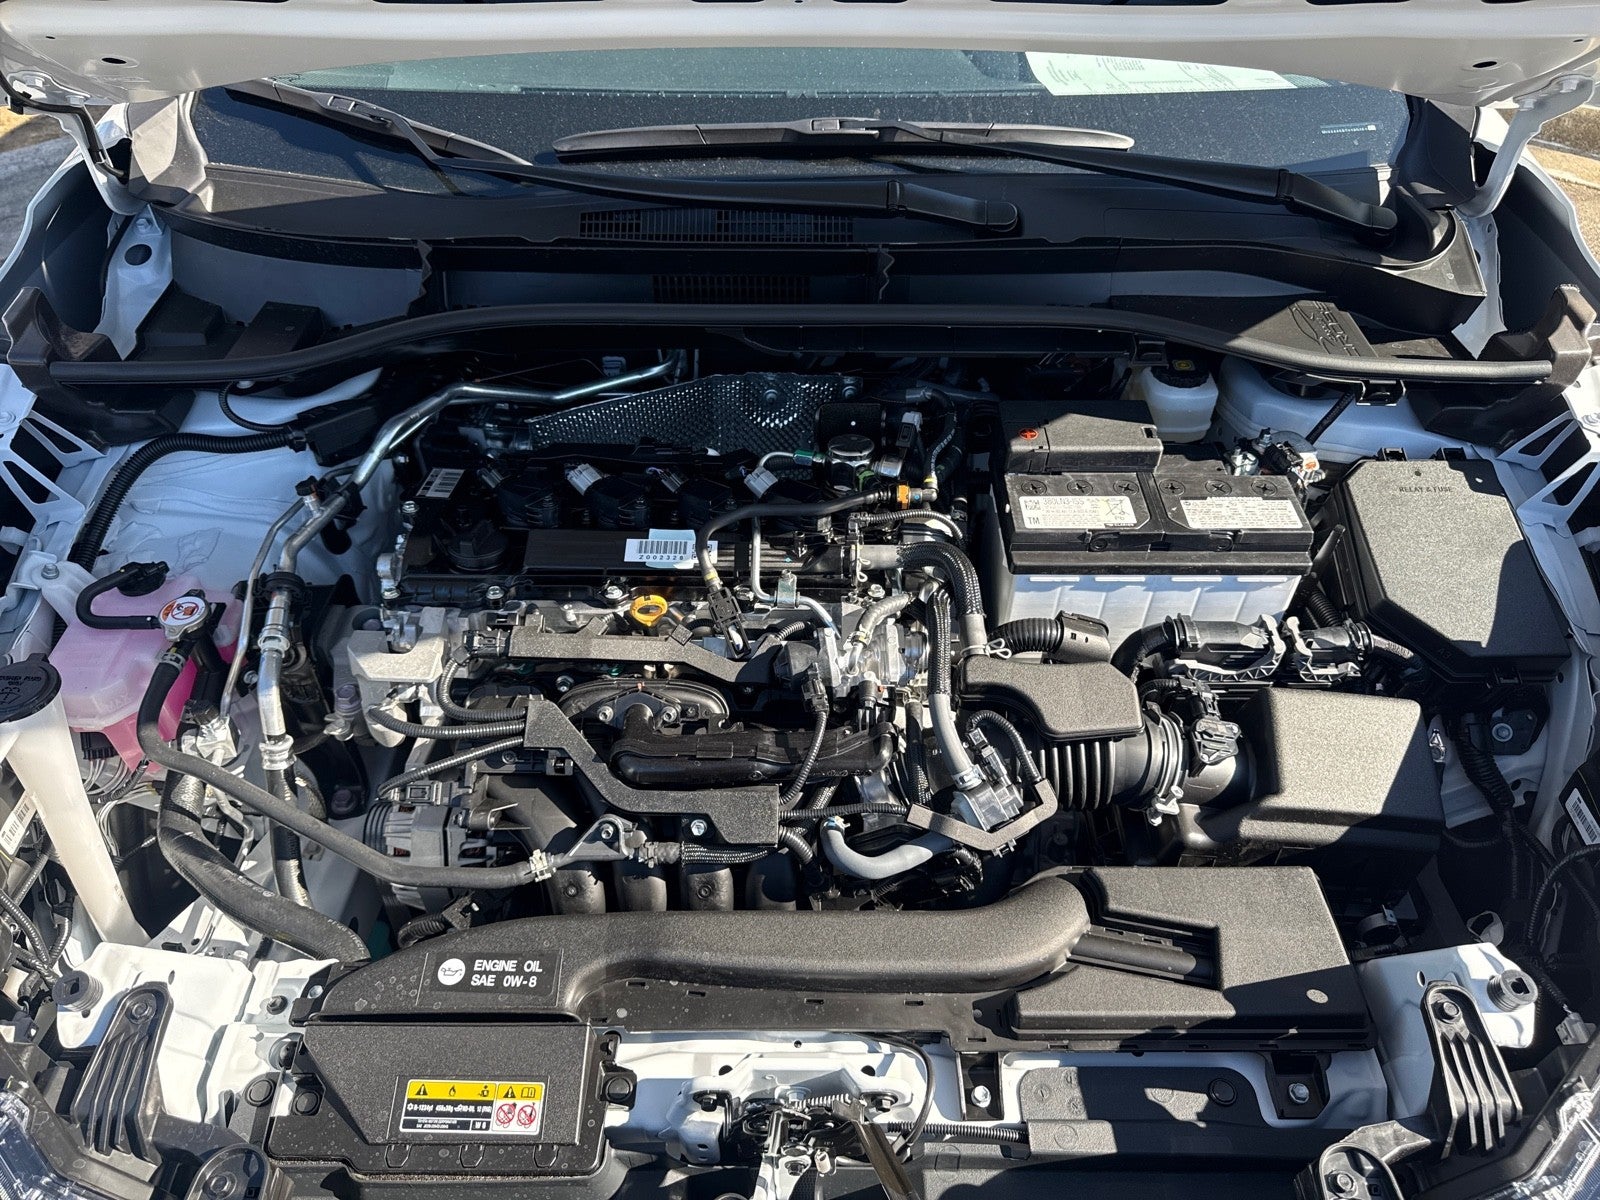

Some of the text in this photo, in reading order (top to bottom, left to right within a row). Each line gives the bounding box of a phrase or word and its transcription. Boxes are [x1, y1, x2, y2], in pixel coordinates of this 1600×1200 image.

[1027, 516, 1040, 525] TM
[474, 959, 543, 972] ENGINE OIL
[471, 974, 538, 987] SAE 0W-8
